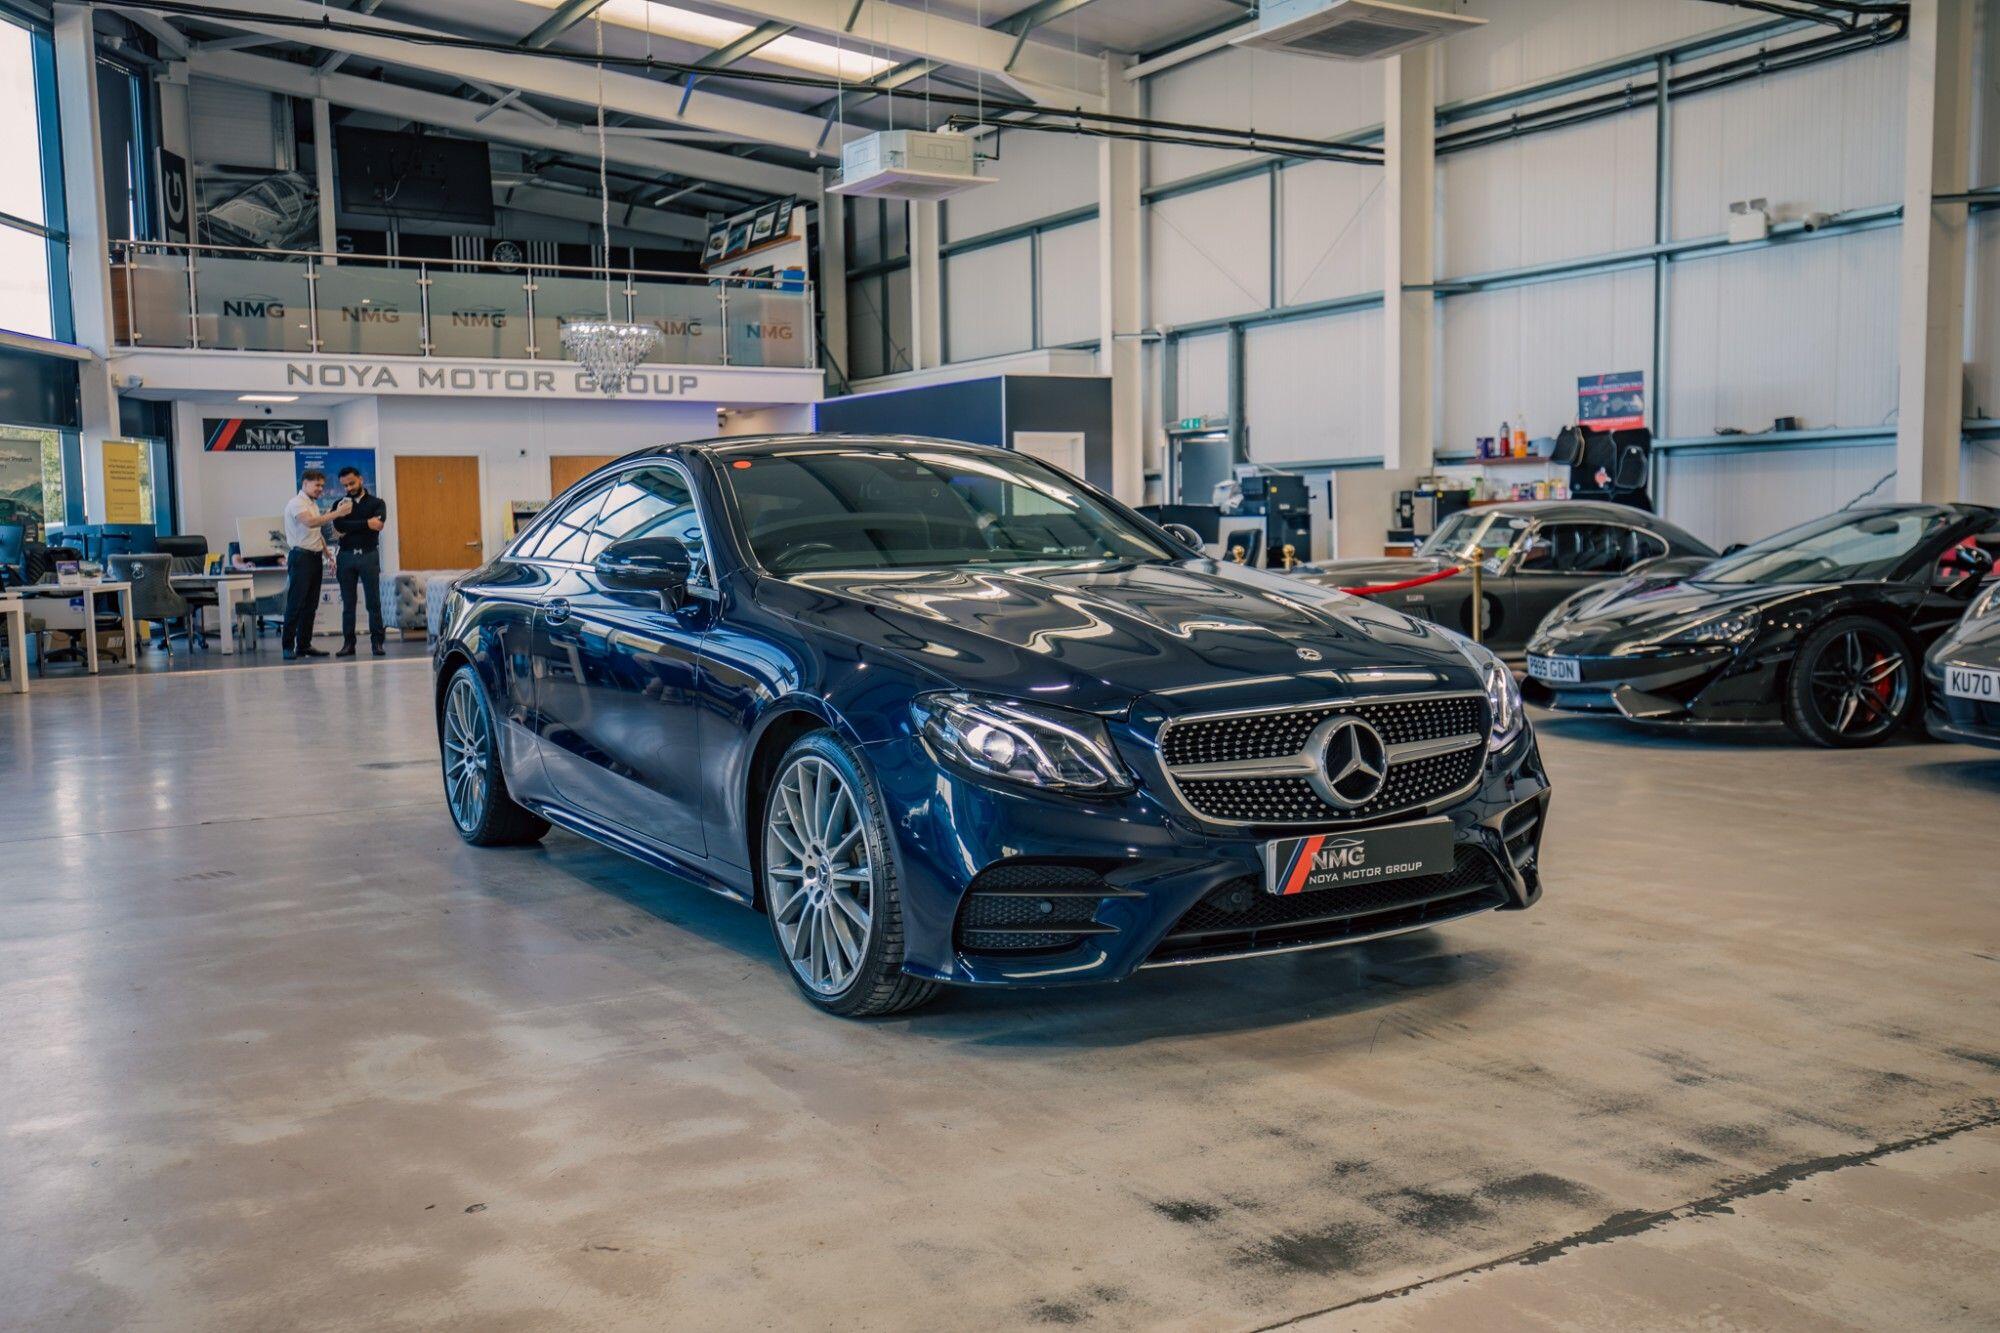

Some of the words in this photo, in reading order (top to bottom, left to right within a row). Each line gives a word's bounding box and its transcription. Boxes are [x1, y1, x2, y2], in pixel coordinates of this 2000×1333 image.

[223, 300, 285, 318] NMG
[341, 306, 400, 323] NMG
[451, 311, 507, 328] NMG
[746, 323, 793, 340] NMG
[286, 363, 398, 388] NOYA
[418, 367, 556, 392] MOTOR
[574, 372, 698, 395] GOUP
[245, 428, 305, 445] NMG
[1952, 671, 1991, 695] KU70
[1311, 847, 1365, 870] NMG
[1309, 874, 1338, 884] NOYA
[1343, 867, 1381, 879] MOTOR
[1385, 861, 1422, 874] GROUP
